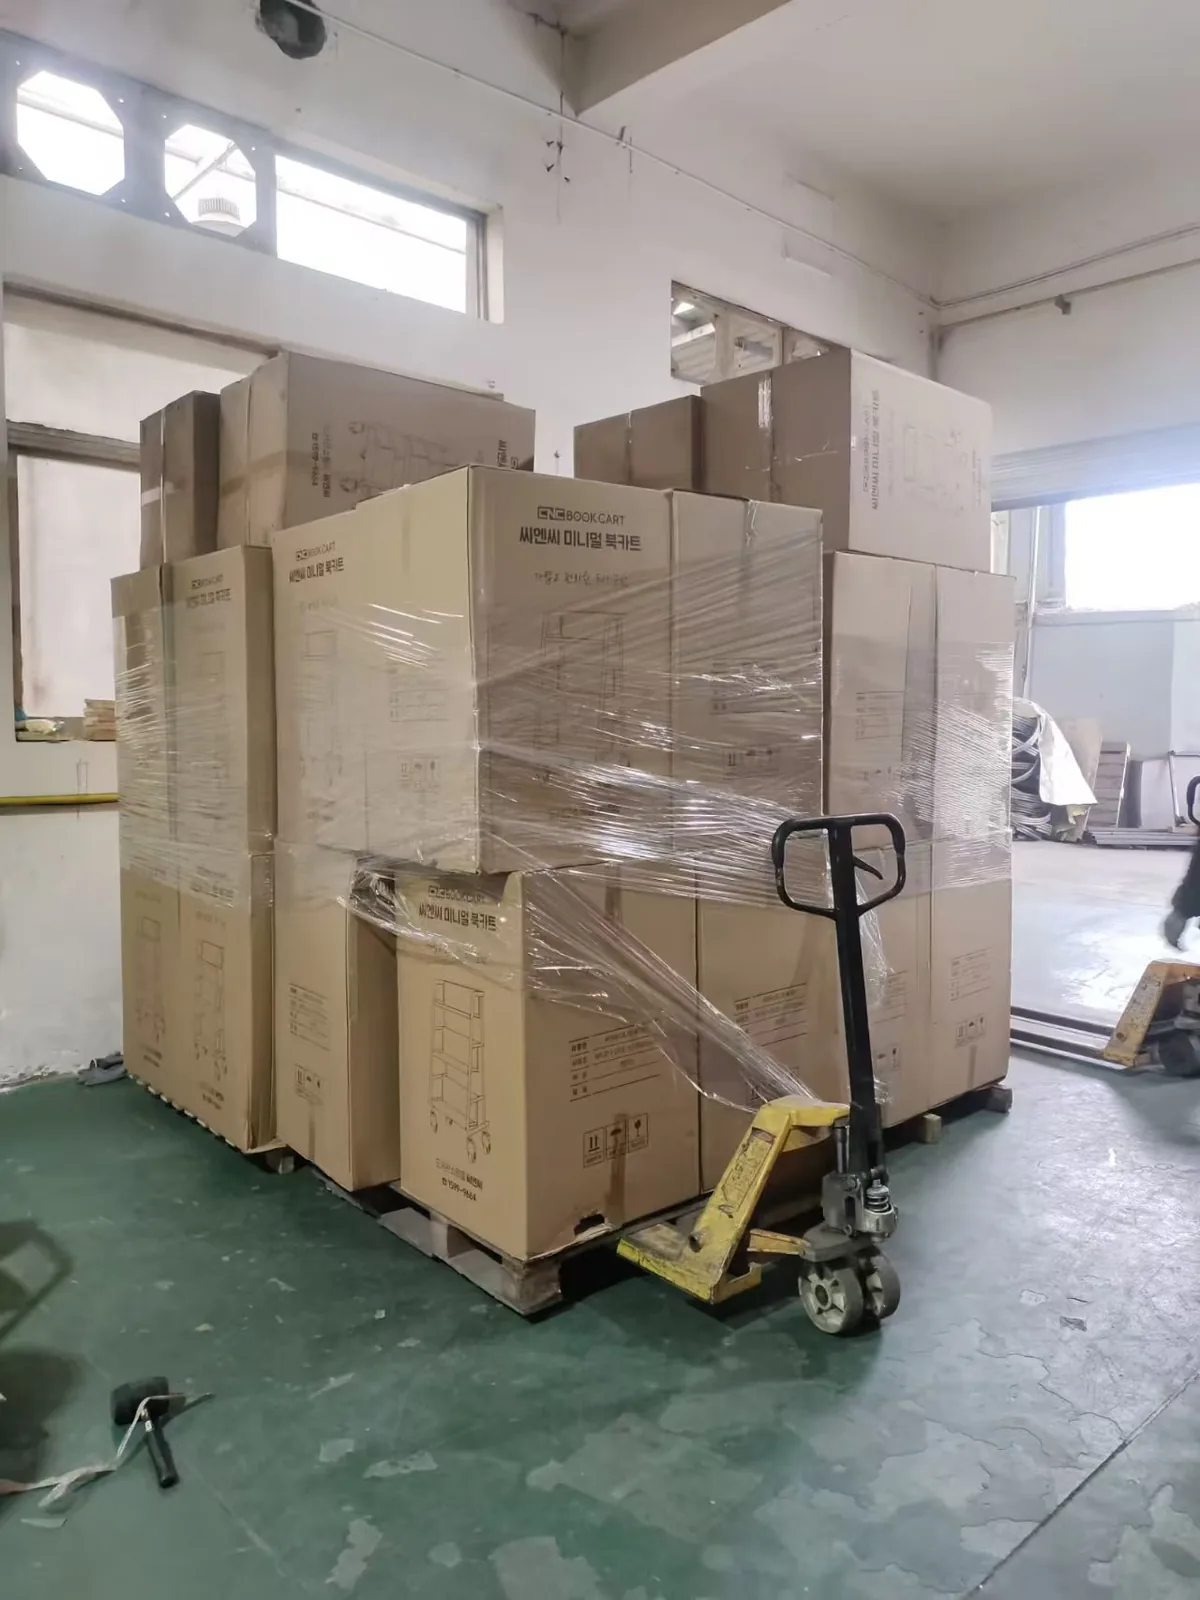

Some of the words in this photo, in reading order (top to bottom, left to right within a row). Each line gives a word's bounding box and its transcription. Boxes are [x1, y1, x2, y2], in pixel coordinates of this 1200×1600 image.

[519, 526, 560, 545] 씨엔씨
[564, 530, 603, 549] 미니멀
[605, 533, 642, 552] 북카트
